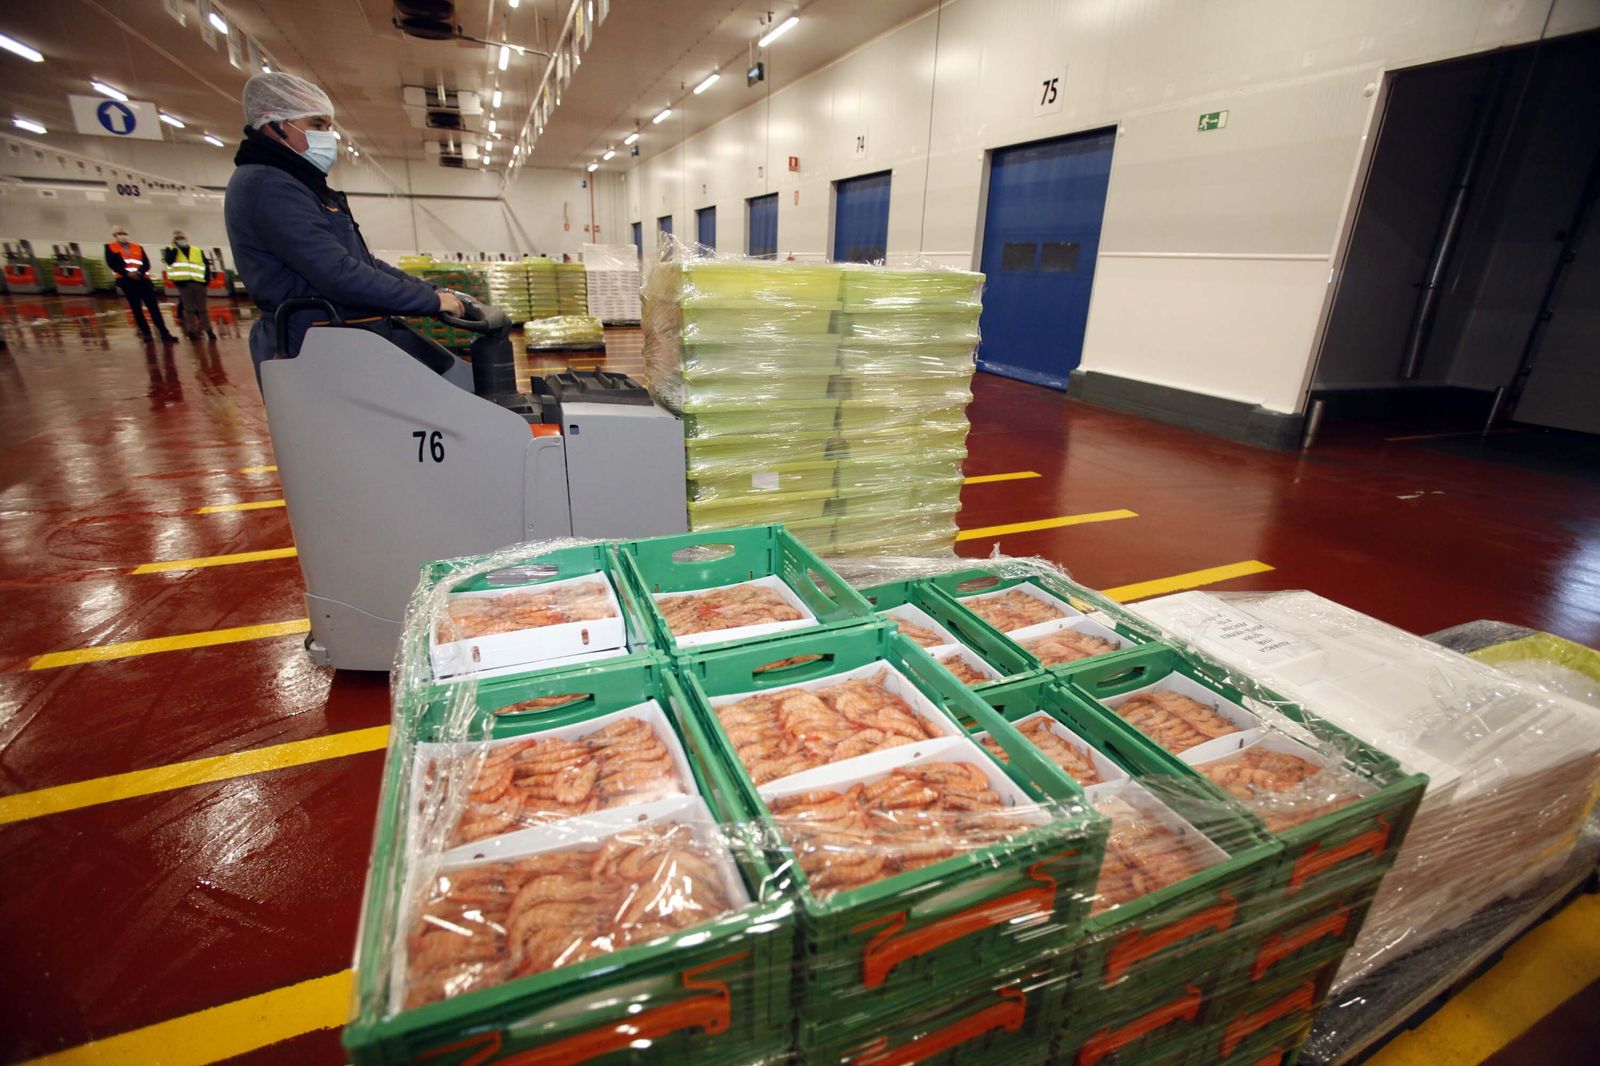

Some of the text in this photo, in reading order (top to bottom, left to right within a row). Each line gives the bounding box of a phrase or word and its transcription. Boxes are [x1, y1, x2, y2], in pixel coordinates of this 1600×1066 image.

[1041, 77, 1059, 106] 75
[856, 135, 865, 153] 74
[116, 183, 141, 197] 003
[412, 430, 445, 463] 76
